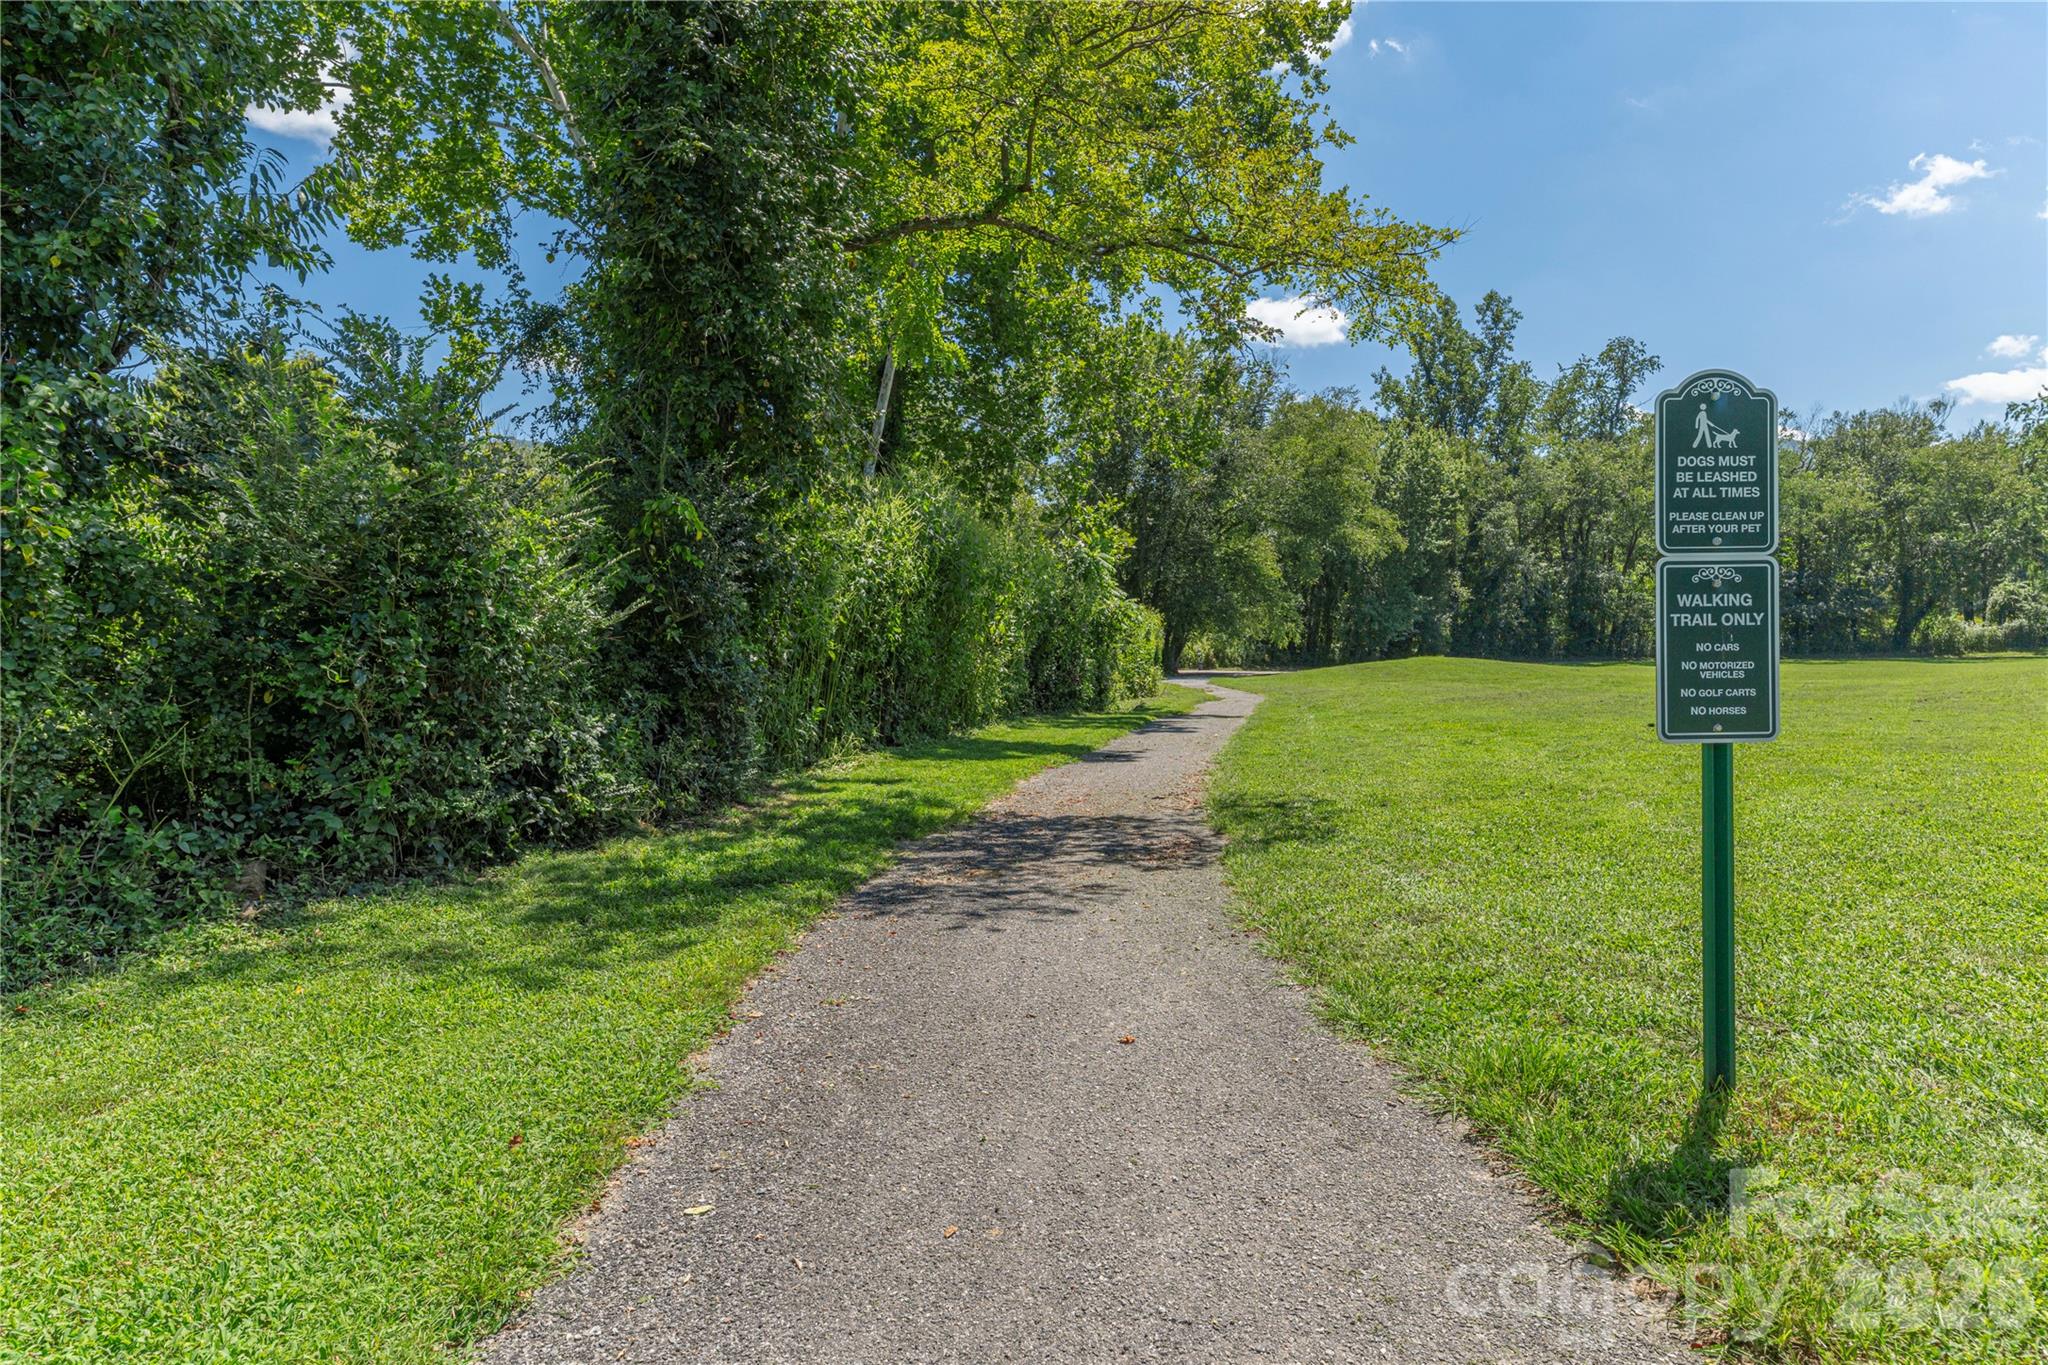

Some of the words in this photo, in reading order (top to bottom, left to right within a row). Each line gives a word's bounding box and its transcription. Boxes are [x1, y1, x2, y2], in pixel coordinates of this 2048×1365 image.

[1677, 456, 1715, 467] DOGS
[1718, 455, 1756, 467] MUST
[1676, 472, 1693, 482] BE
[1697, 471, 1757, 482] LEASHED
[1673, 488, 1689, 498] AT
[1692, 487, 1717, 498] ALL
[1720, 487, 1761, 498] TIMES
[1669, 512, 1709, 521] PLEASE
[1711, 512, 1747, 521] CLEAN
[1749, 511, 1765, 520] UP
[1672, 525, 1706, 534] AFTER
[1708, 524, 1739, 533] YOUR
[1741, 524, 1762, 533] PET
[1677, 593, 1753, 607] WALKING
[1670, 613, 1717, 627] TRAIL
[1721, 612, 1765, 626] ONLY
[1696, 643, 1712, 652] NO
[1714, 643, 1740, 652] CARS
[1681, 661, 1698, 670] NO
[1699, 661, 1755, 670] MOTORIZED
[1700, 670, 1745, 679] VEHICLES
[1680, 688, 1697, 697] NO
[1698, 688, 1723, 697] GOLF
[1725, 688, 1757, 697] CARTS
[1690, 706, 1706, 715] NO
[1708, 706, 1747, 715] HORSES
